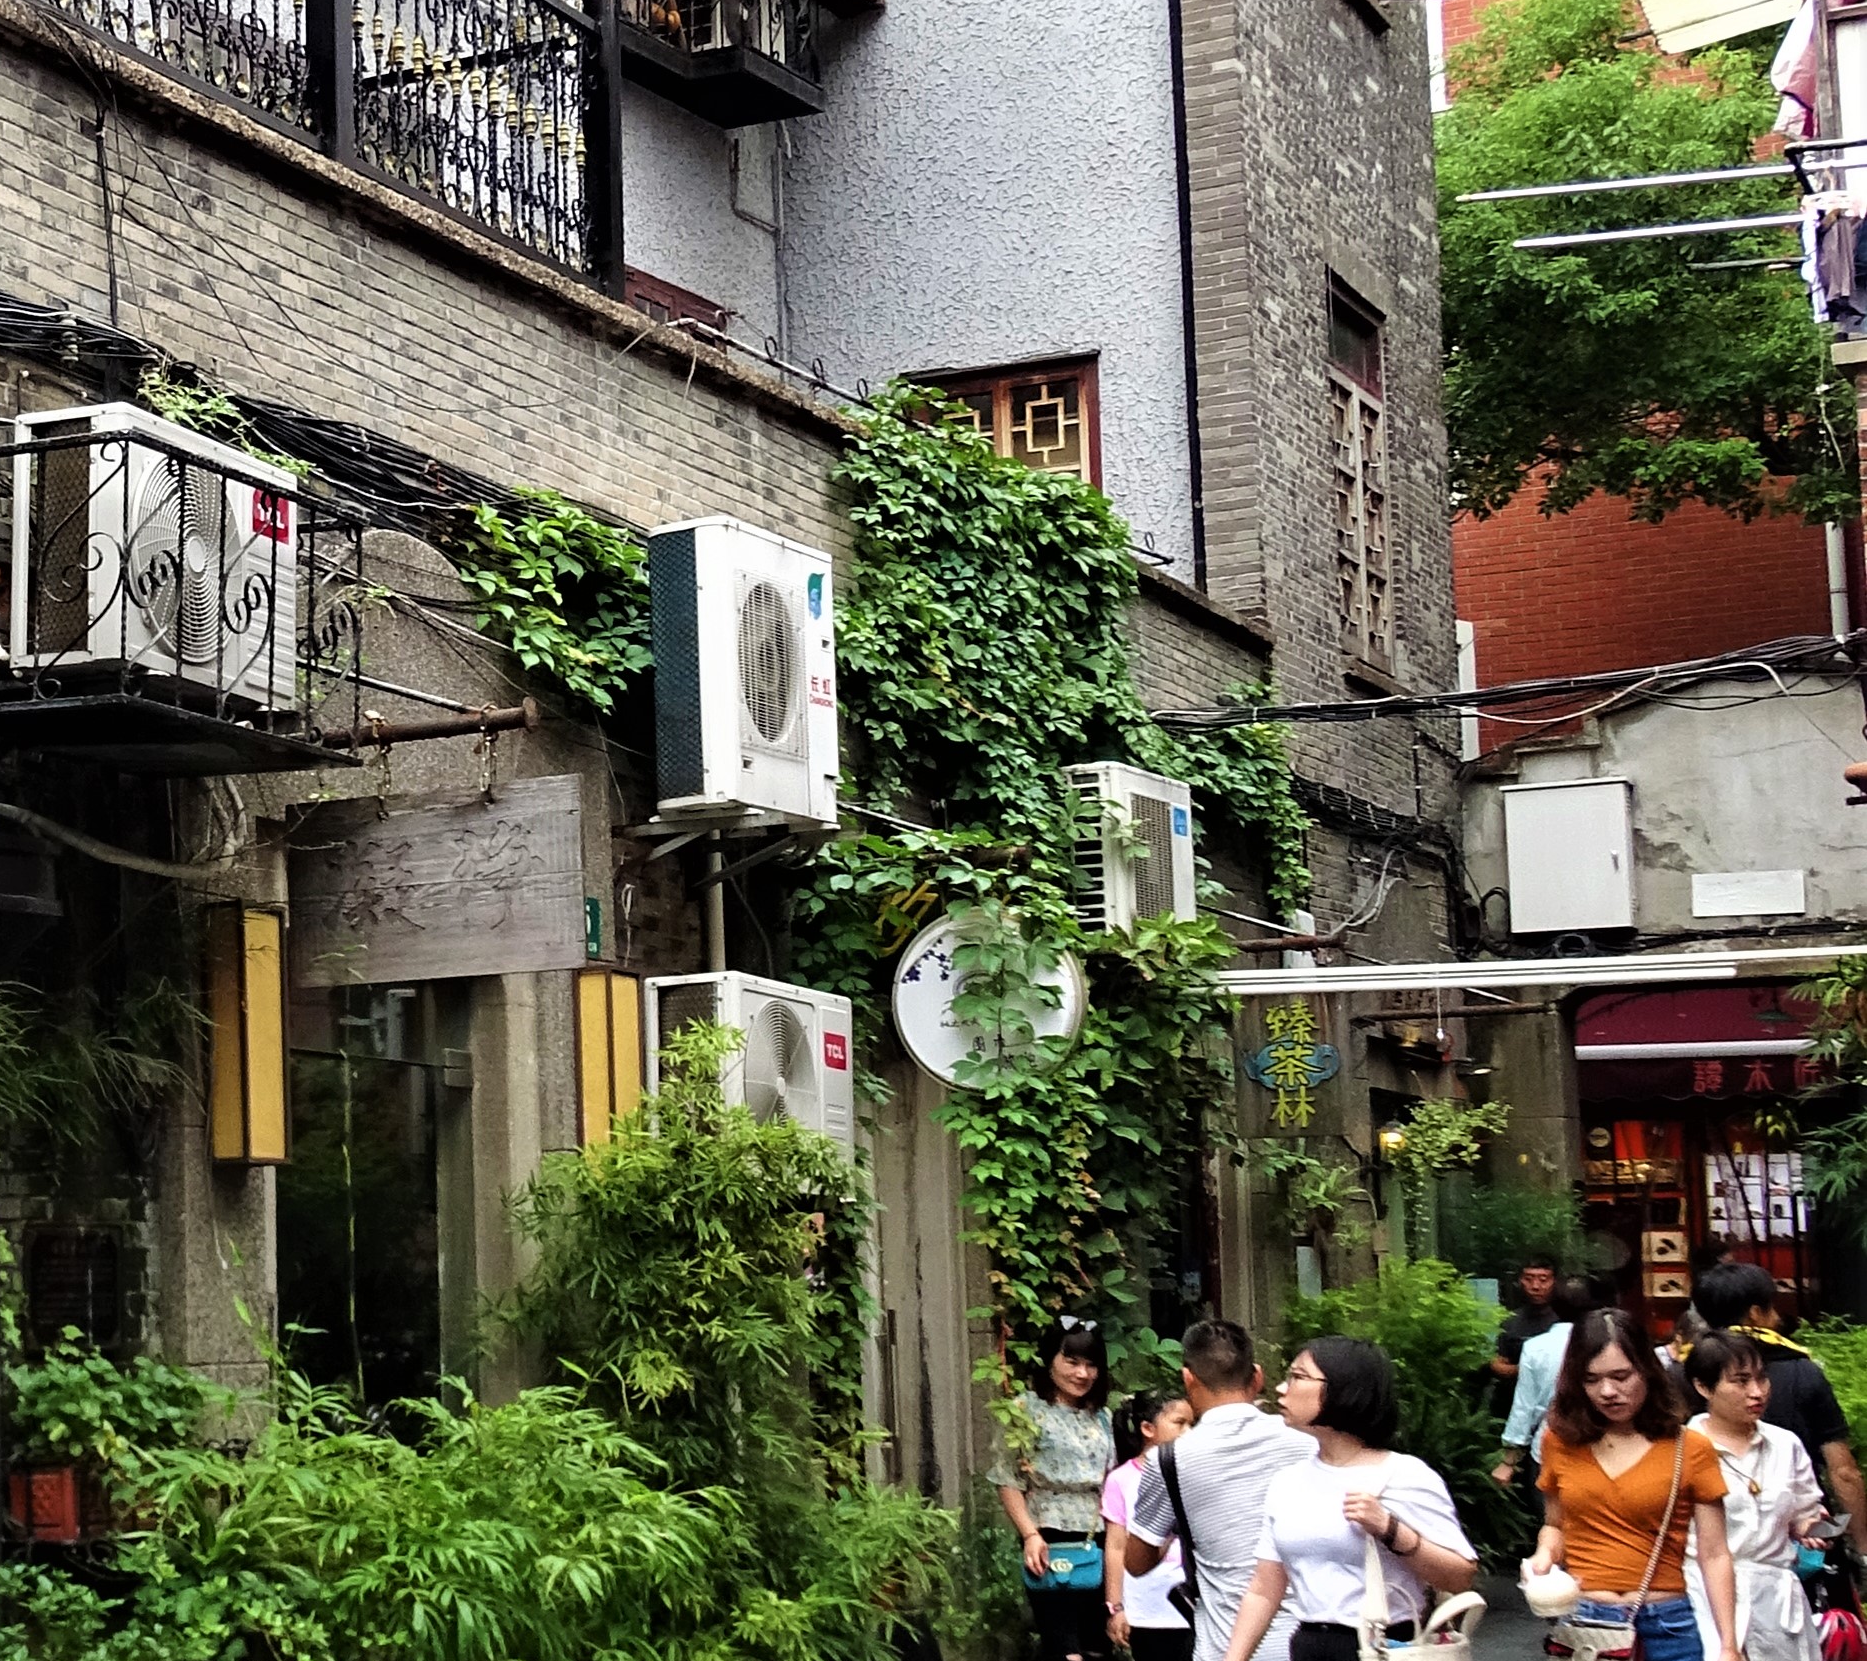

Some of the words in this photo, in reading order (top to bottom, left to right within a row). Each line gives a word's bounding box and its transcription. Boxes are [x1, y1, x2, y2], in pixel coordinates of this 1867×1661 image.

[826, 1043, 845, 1060] TCL
[1263, 999, 1325, 1128] 臻茶林
